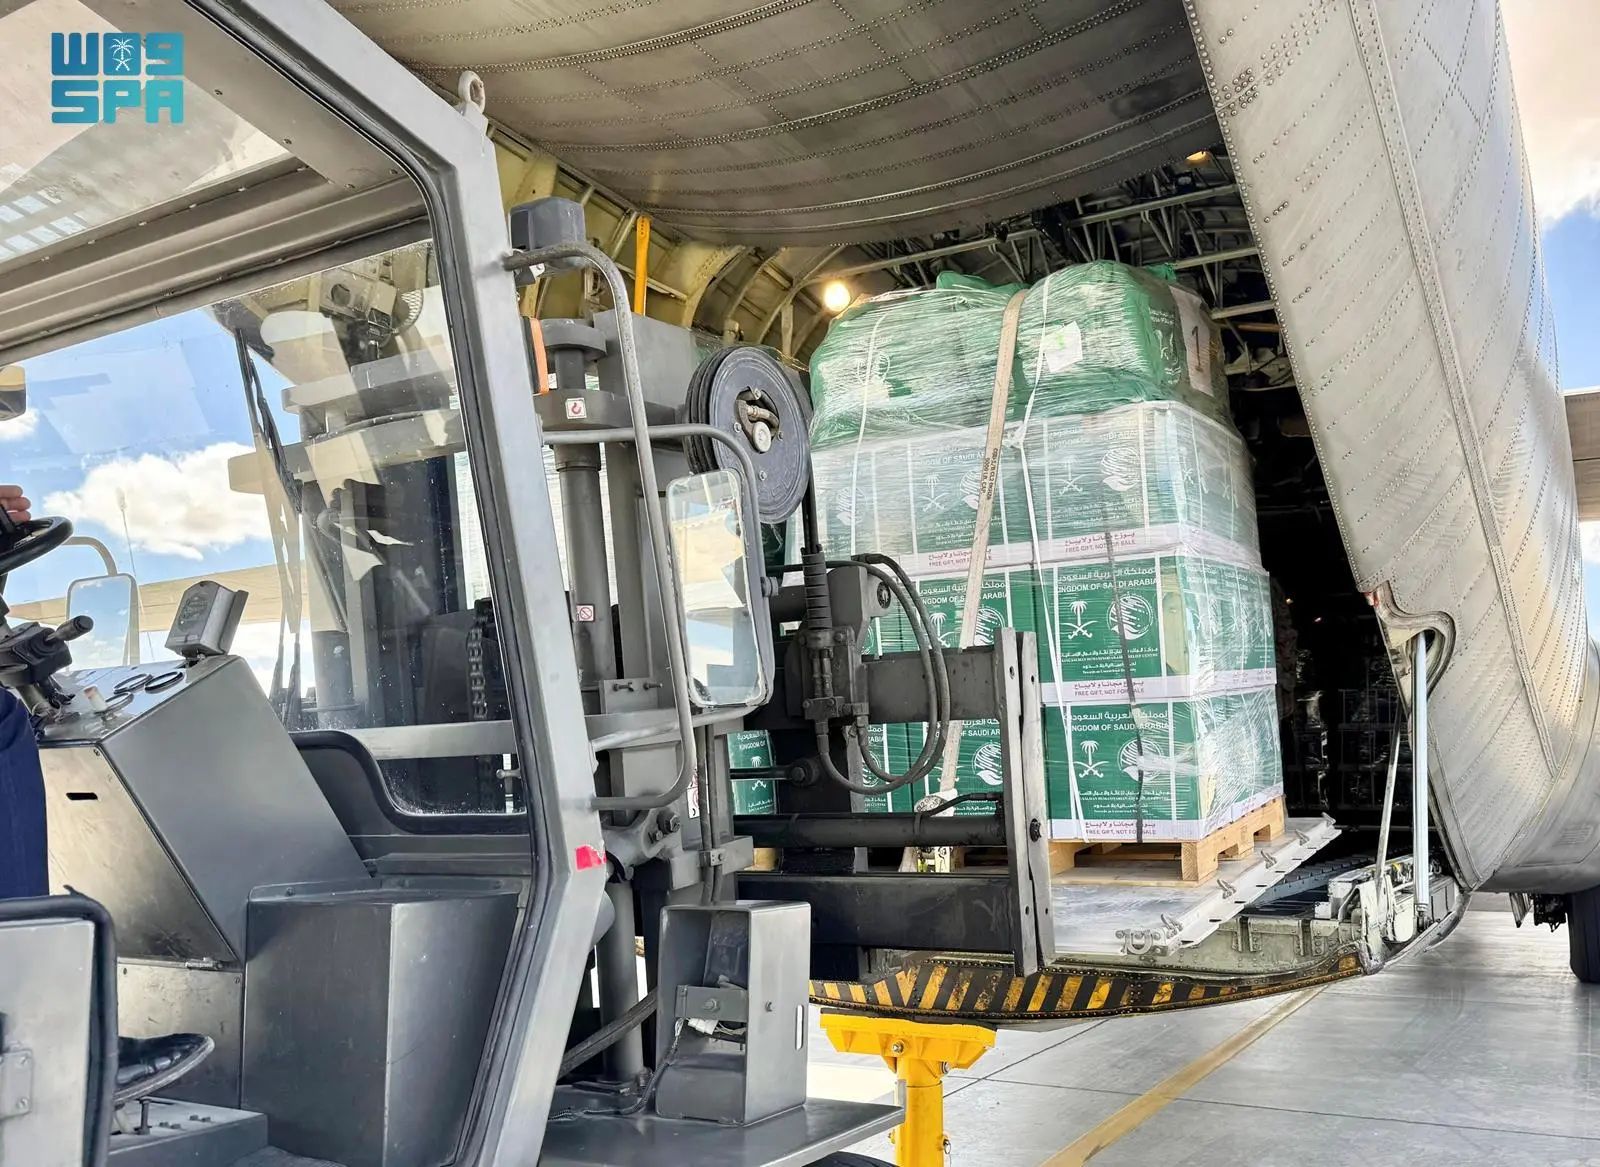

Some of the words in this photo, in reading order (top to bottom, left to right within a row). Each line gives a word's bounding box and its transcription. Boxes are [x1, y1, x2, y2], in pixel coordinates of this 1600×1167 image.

[1102, 580, 1126, 589] SADI
[922, 597, 948, 605] NGDOM
[1071, 724, 1100, 732] NGDOM
[1101, 723, 1111, 731] OF
[1113, 723, 1135, 731] SAUD
[968, 729, 990, 737] SAUDI
